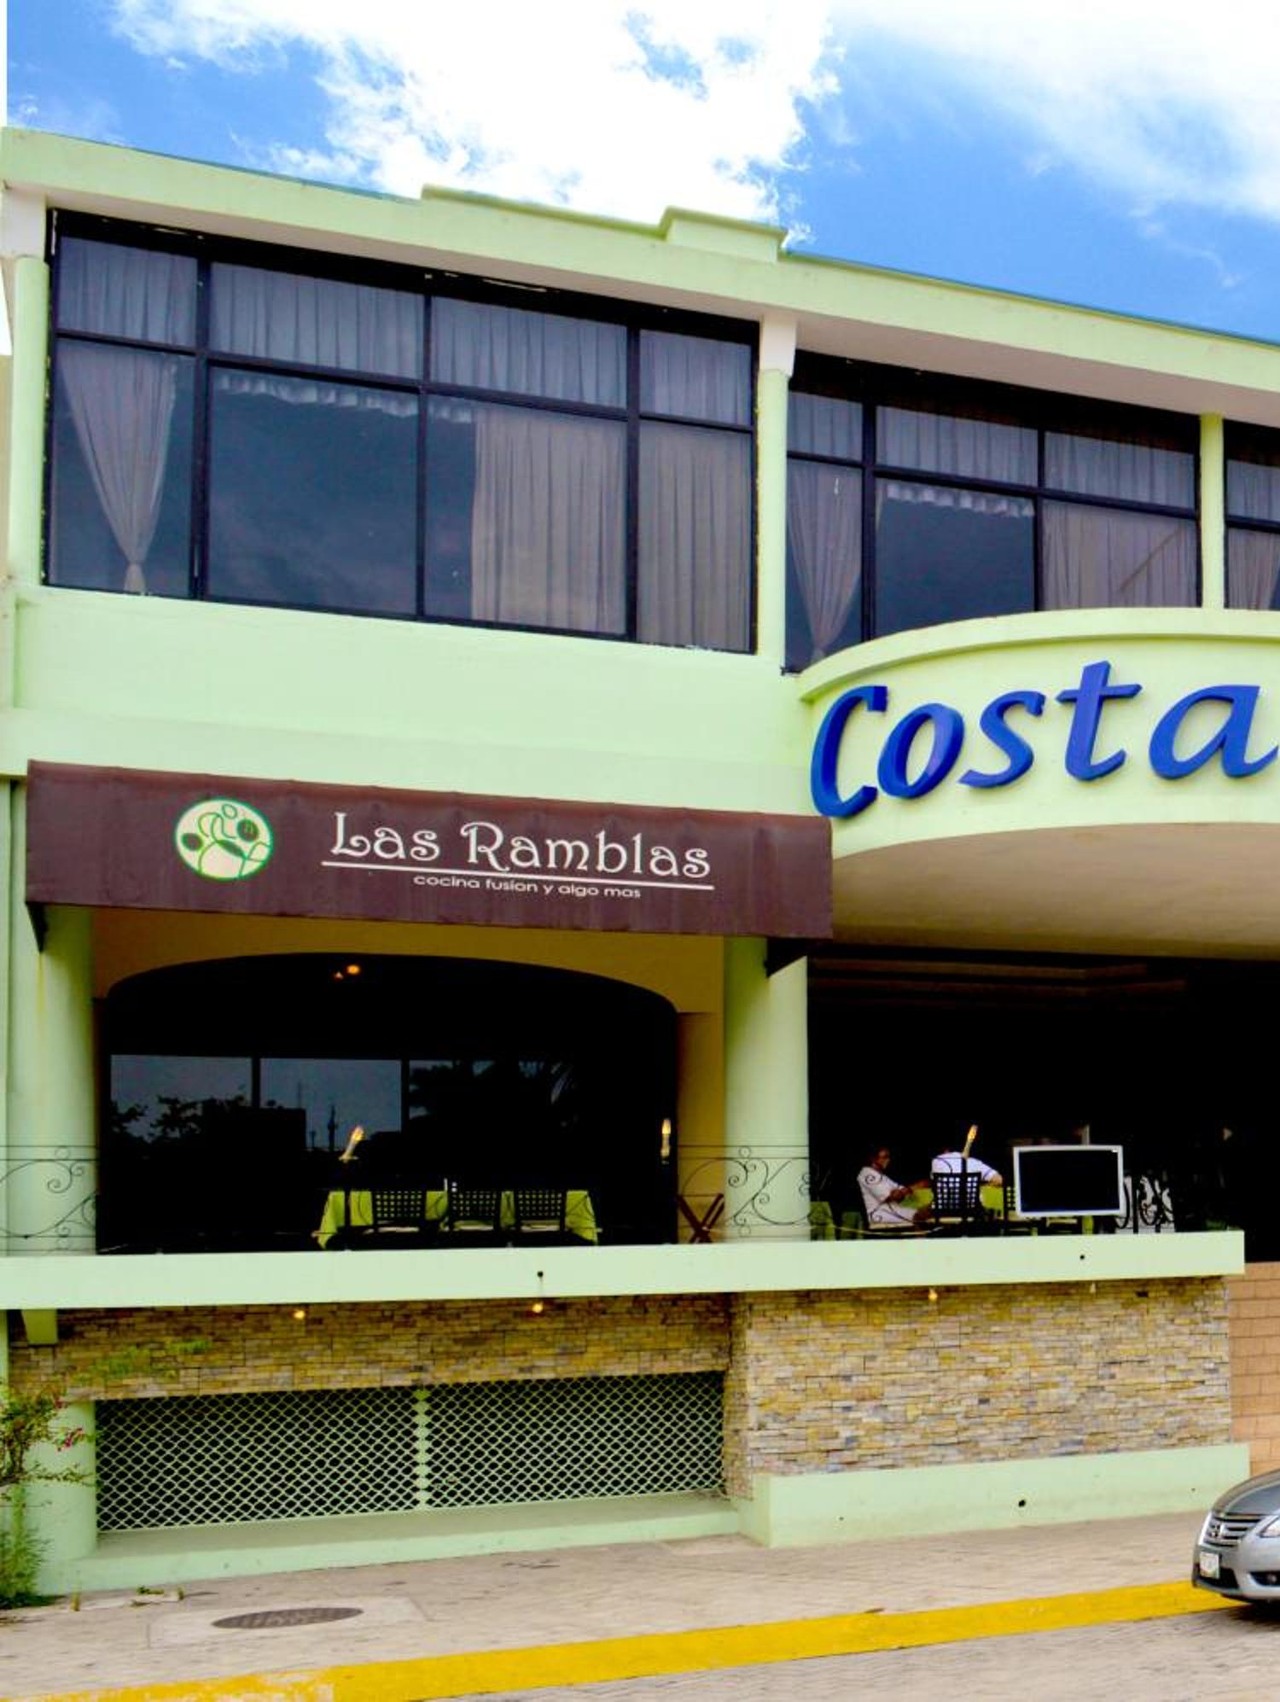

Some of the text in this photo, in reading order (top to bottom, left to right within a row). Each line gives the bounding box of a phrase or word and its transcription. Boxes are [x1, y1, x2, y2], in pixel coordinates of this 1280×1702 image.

[810, 660, 1280, 818] Costa
[330, 811, 711, 879] Las Ramblas
[413, 875, 641, 898] cocina fusion y algo mas
